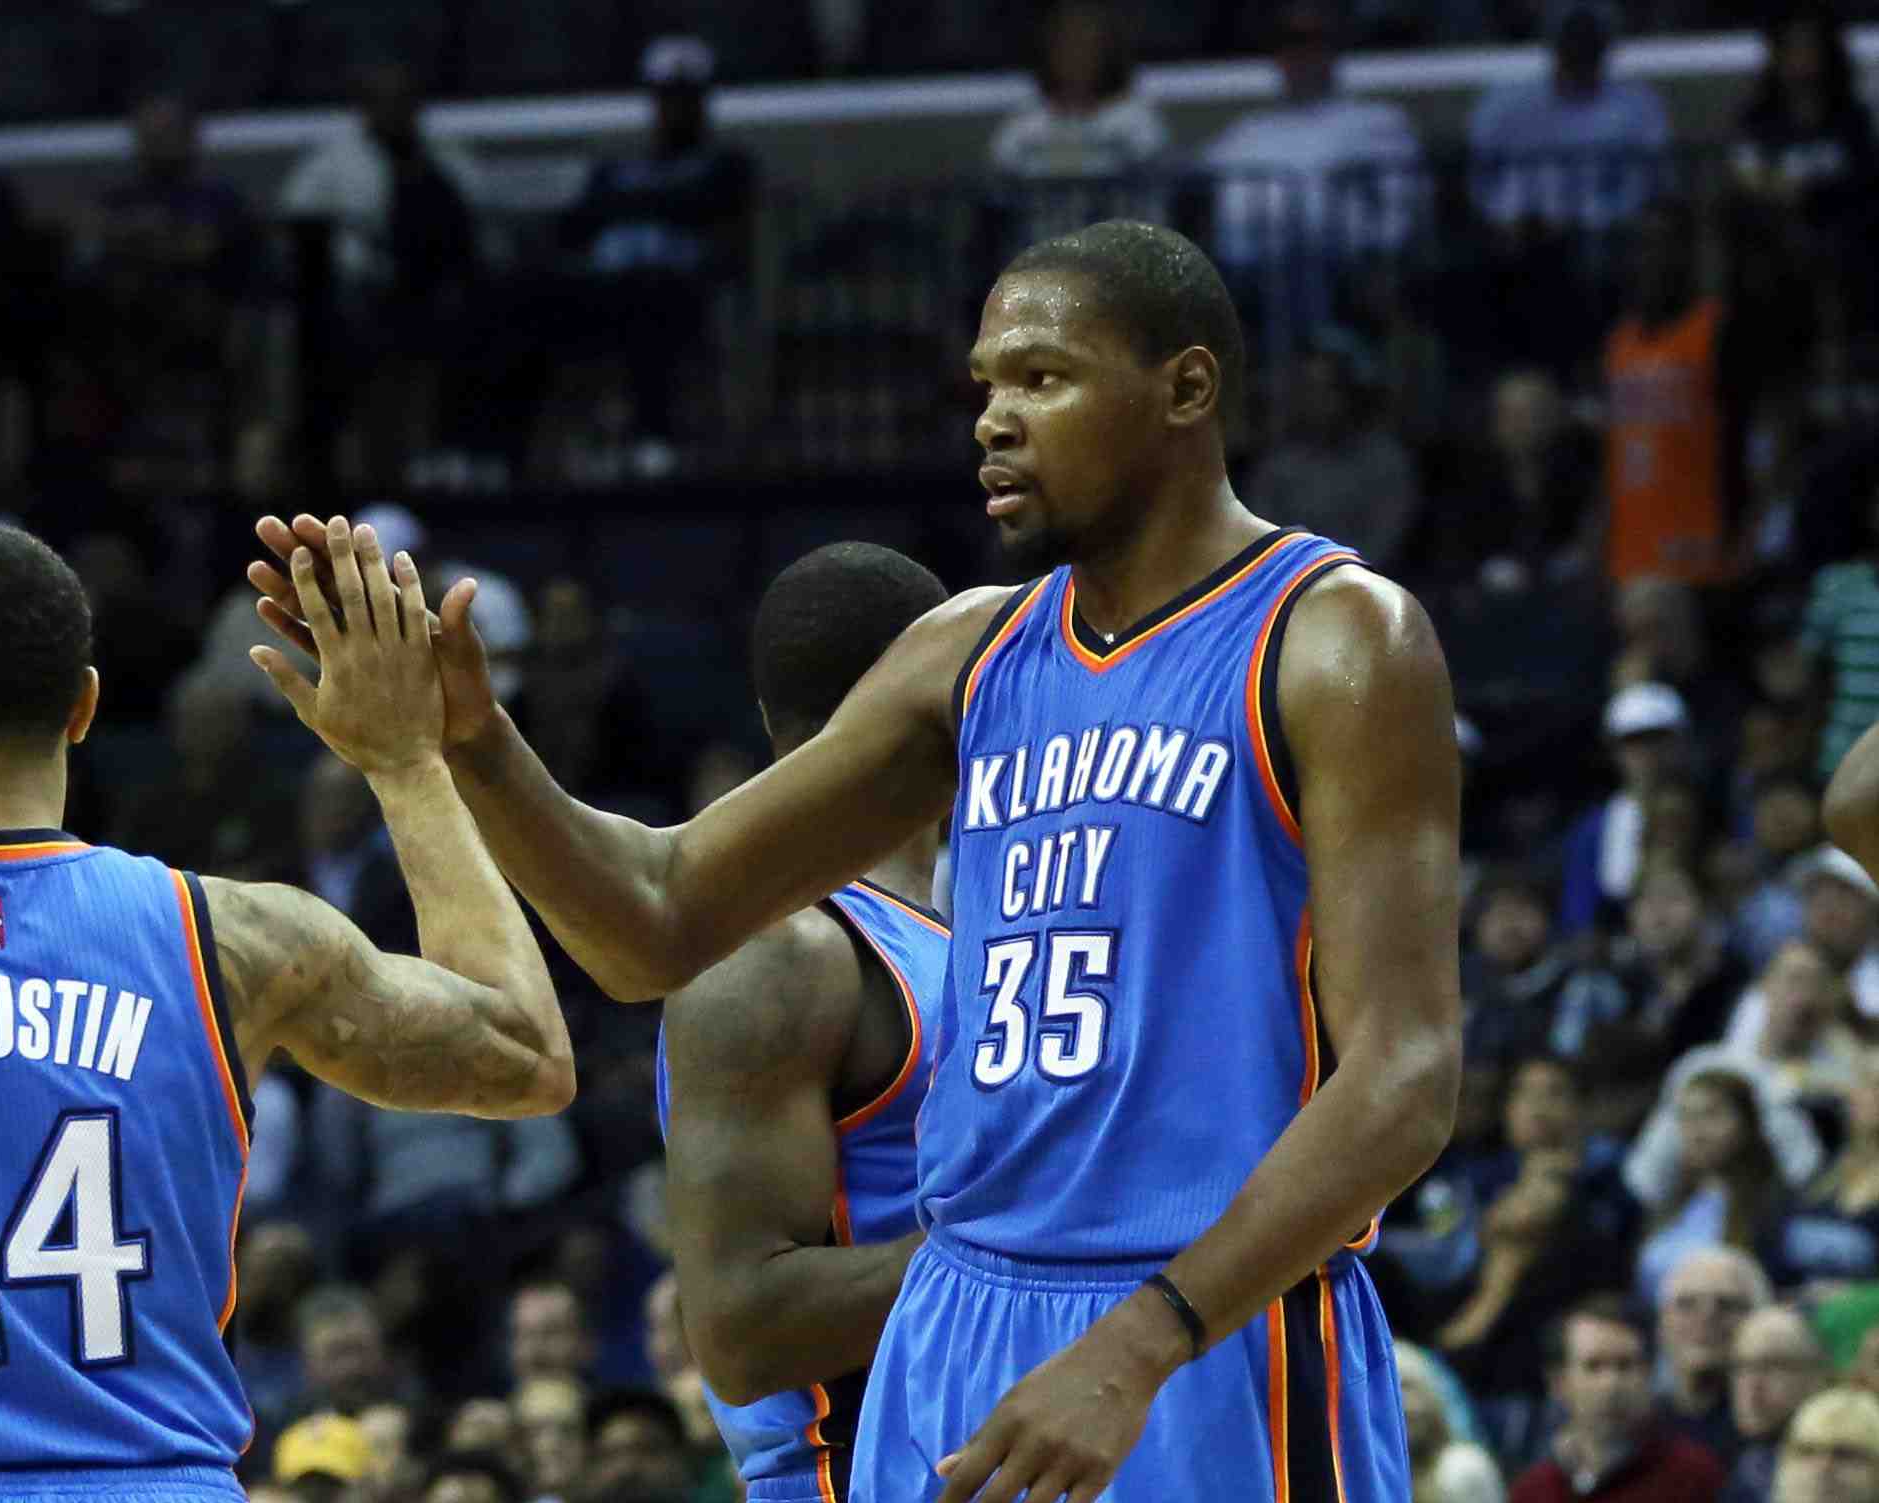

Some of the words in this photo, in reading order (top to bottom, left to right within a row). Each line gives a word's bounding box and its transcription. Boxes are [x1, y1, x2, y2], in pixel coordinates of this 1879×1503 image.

[964, 725, 1231, 831] KLAHOMA
[1001, 825, 1116, 921] CITY
[971, 929, 1117, 1090] 35
